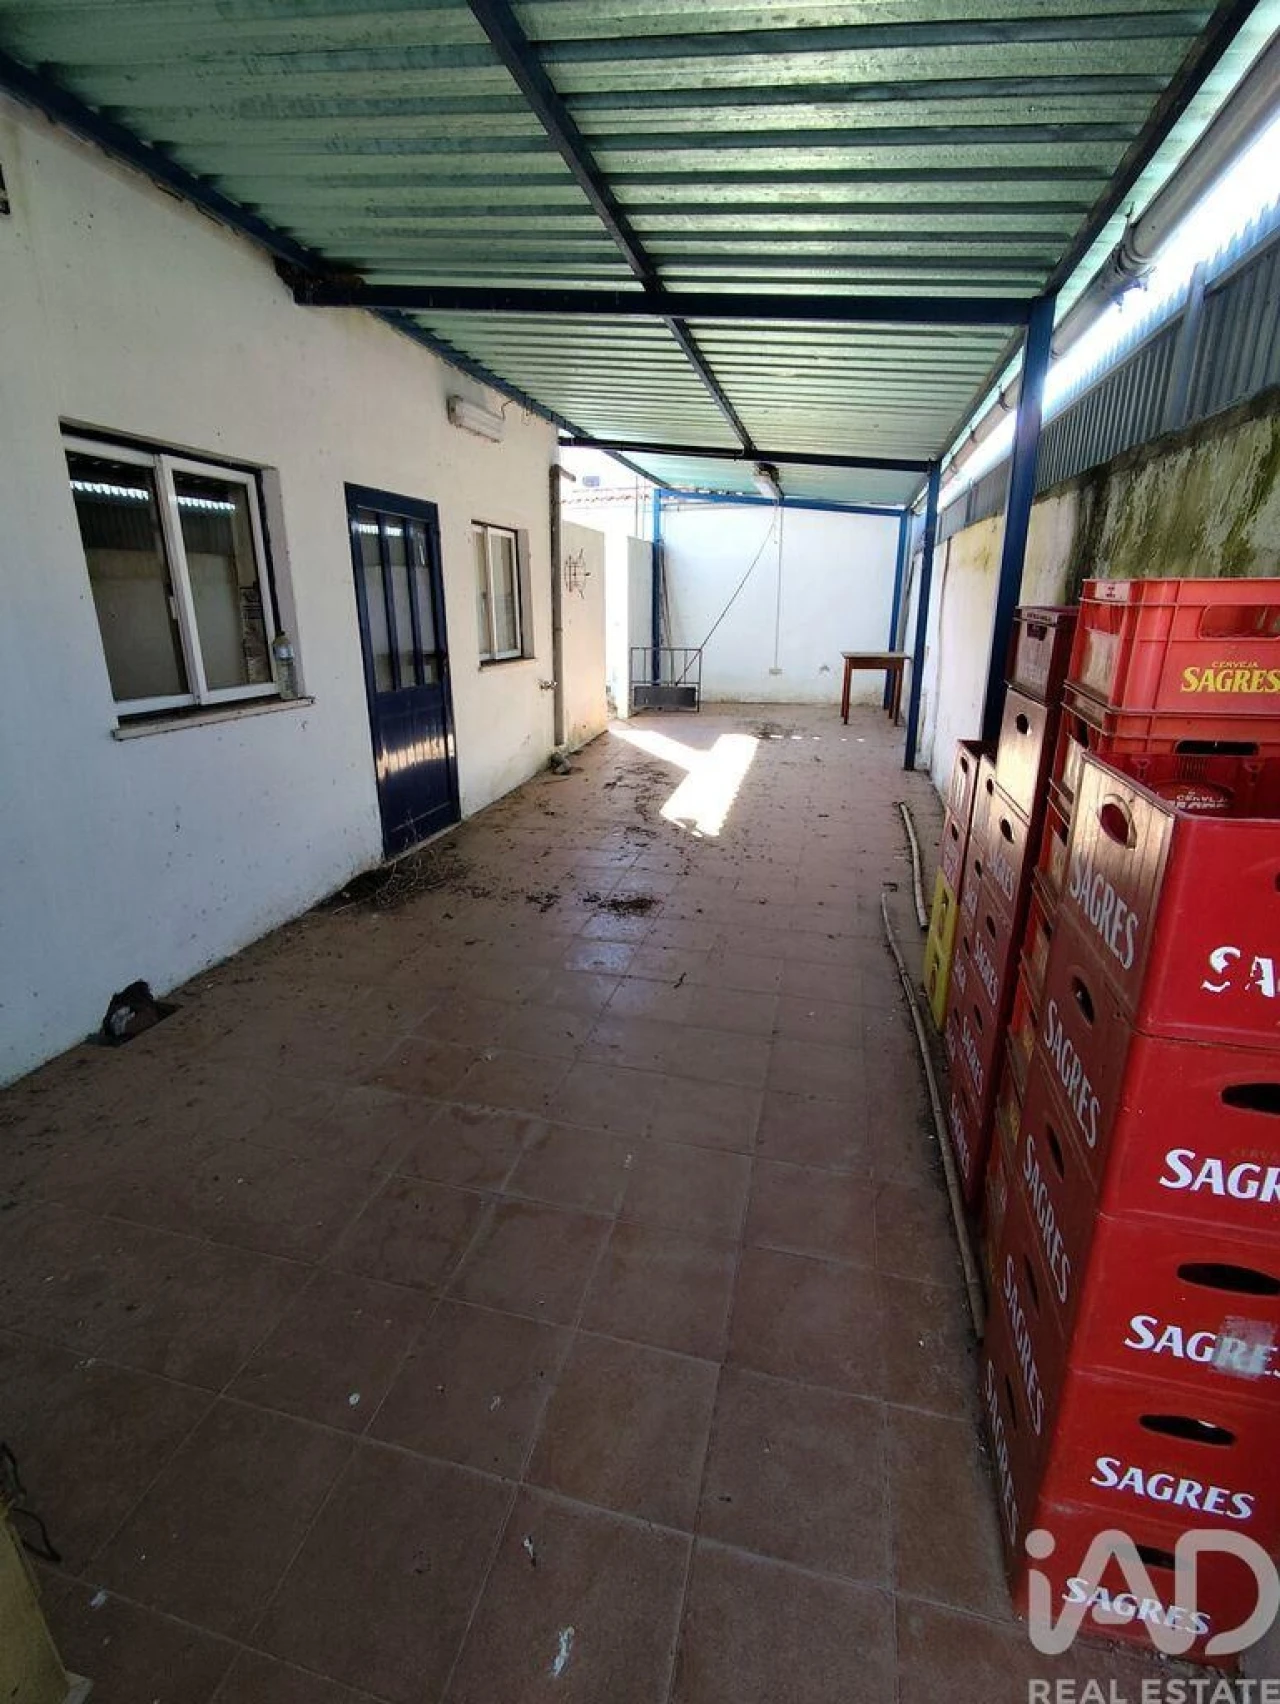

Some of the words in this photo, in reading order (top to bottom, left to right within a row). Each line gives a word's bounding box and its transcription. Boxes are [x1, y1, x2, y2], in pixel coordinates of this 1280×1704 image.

[1180, 666, 1280, 694] SAGRES
[1068, 848, 1138, 971] SAGRES
[1043, 1000, 1100, 1148] SAGRES
[1023, 1133, 1071, 1304] SAGRES
[1003, 1254, 1045, 1437] SAGRES
[1124, 1314, 1280, 1378] SAGRE
[985, 1358, 1020, 1547] SAGRES
[1091, 1456, 1255, 1520] SAGRES
[1061, 1576, 1211, 1636] SAGRES
